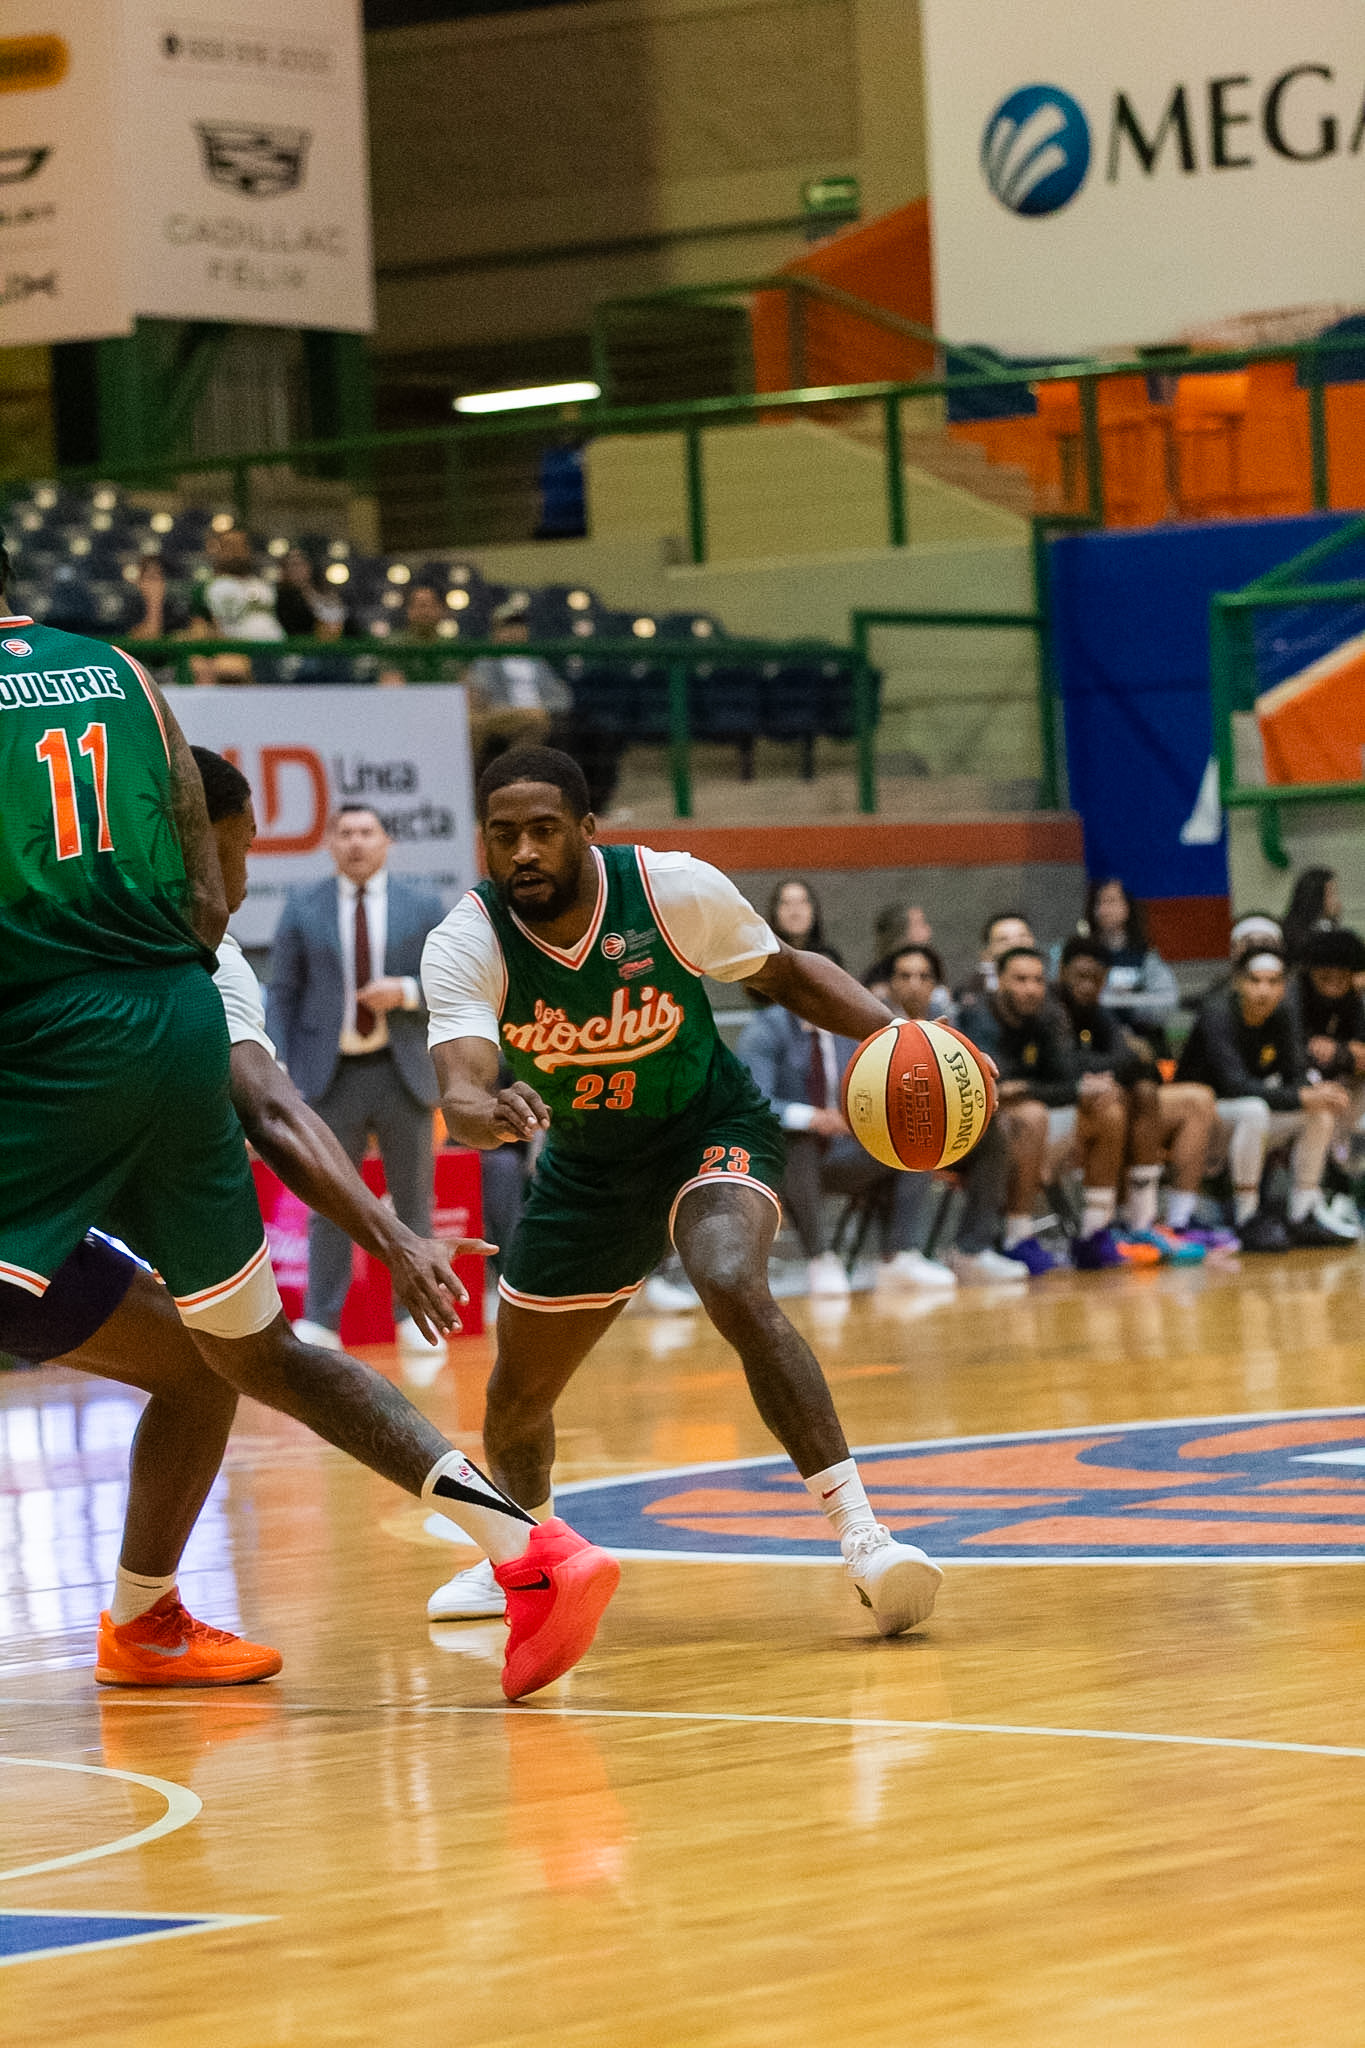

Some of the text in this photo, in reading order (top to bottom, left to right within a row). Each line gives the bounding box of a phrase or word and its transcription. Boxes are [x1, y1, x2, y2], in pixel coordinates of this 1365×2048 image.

[36, 722, 115, 861] 11
[502, 985, 685, 1055] mochis
[534, 999, 567, 1025] los
[571, 1071, 636, 1110] 23
[944, 1051, 973, 1150] SPALDING
[698, 1146, 751, 1175] 23
